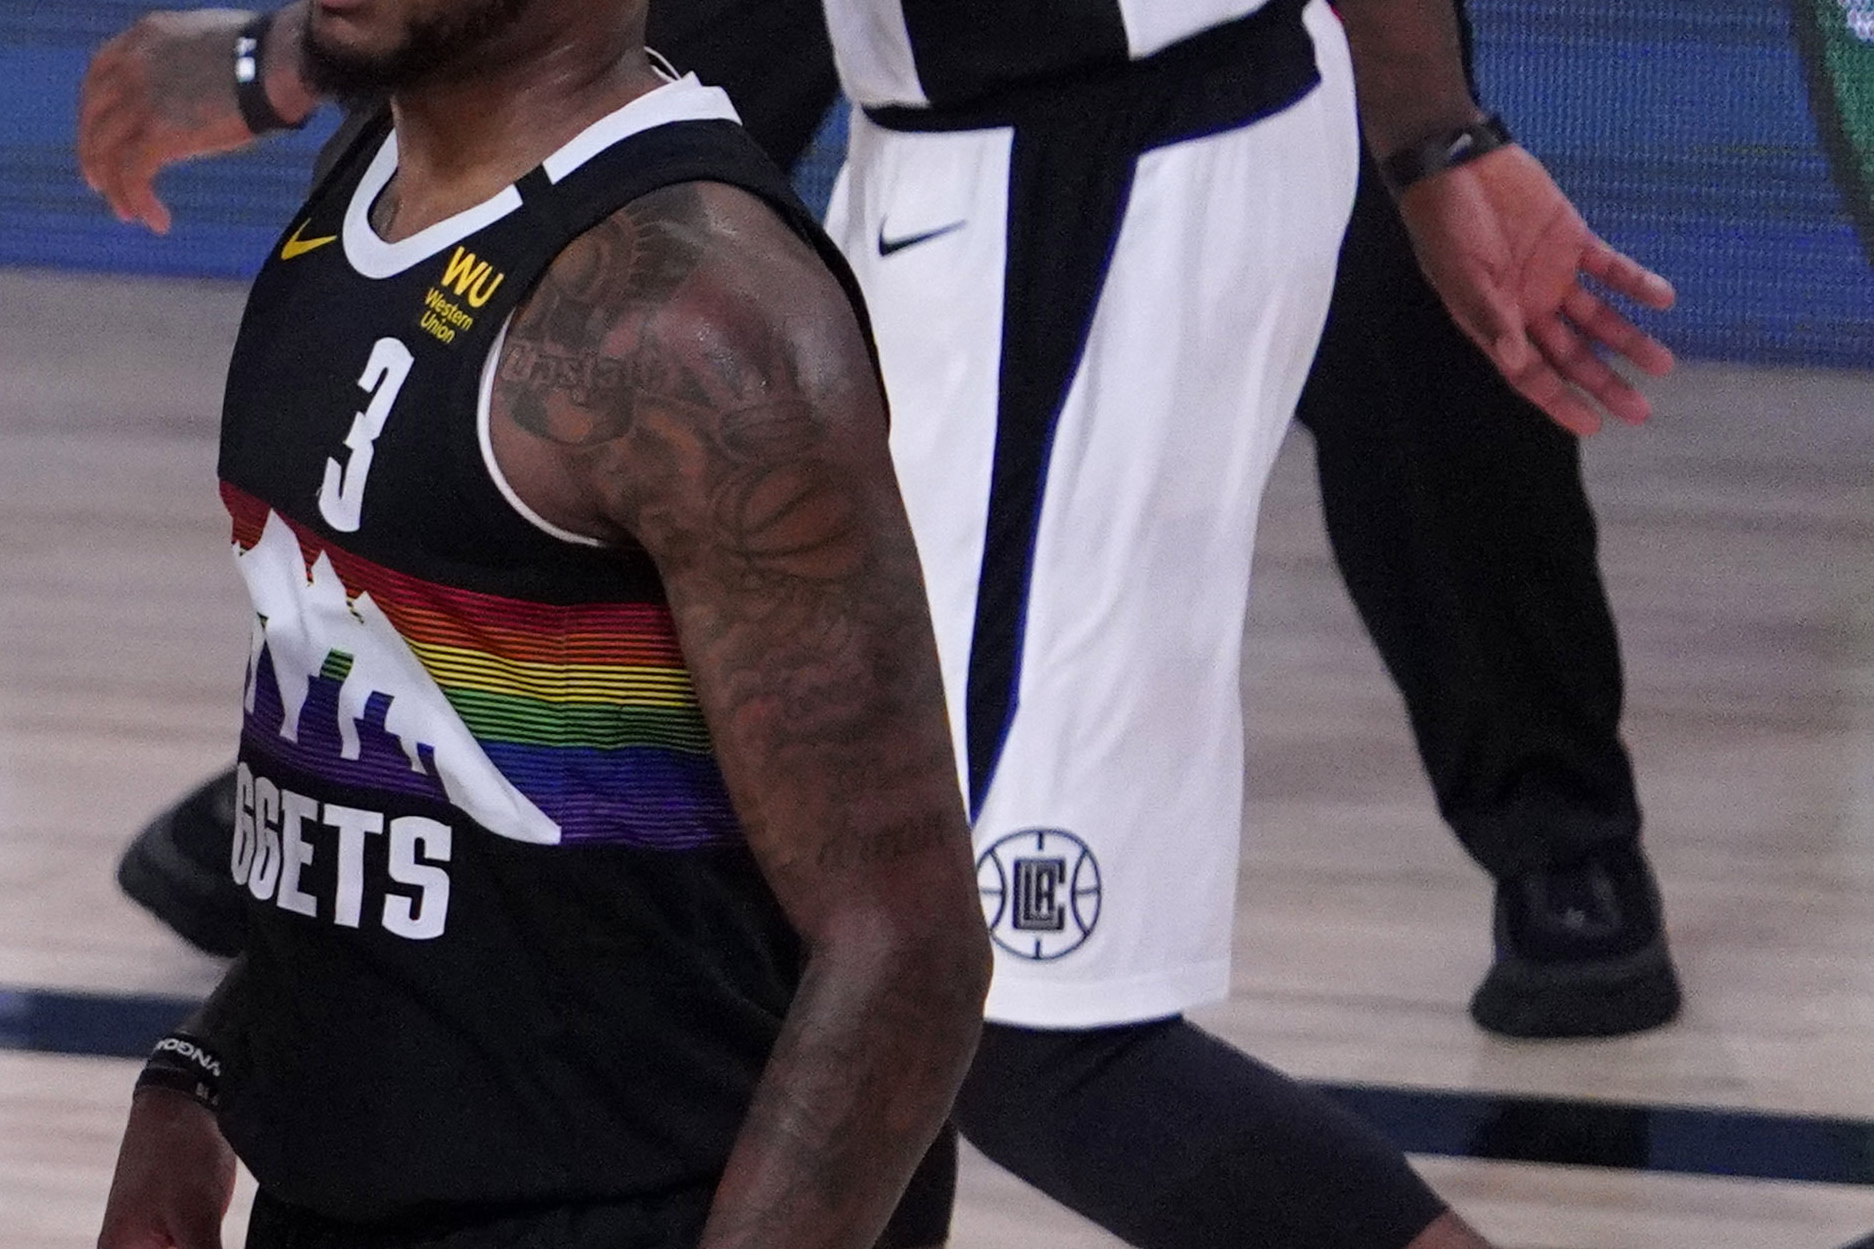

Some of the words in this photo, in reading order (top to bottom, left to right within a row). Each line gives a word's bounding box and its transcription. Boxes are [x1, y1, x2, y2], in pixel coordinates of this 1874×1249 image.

[441, 245, 504, 308] WU
[420, 310, 456, 344] Union
[424, 287, 474, 332] Western
[318, 336, 415, 533] 3
